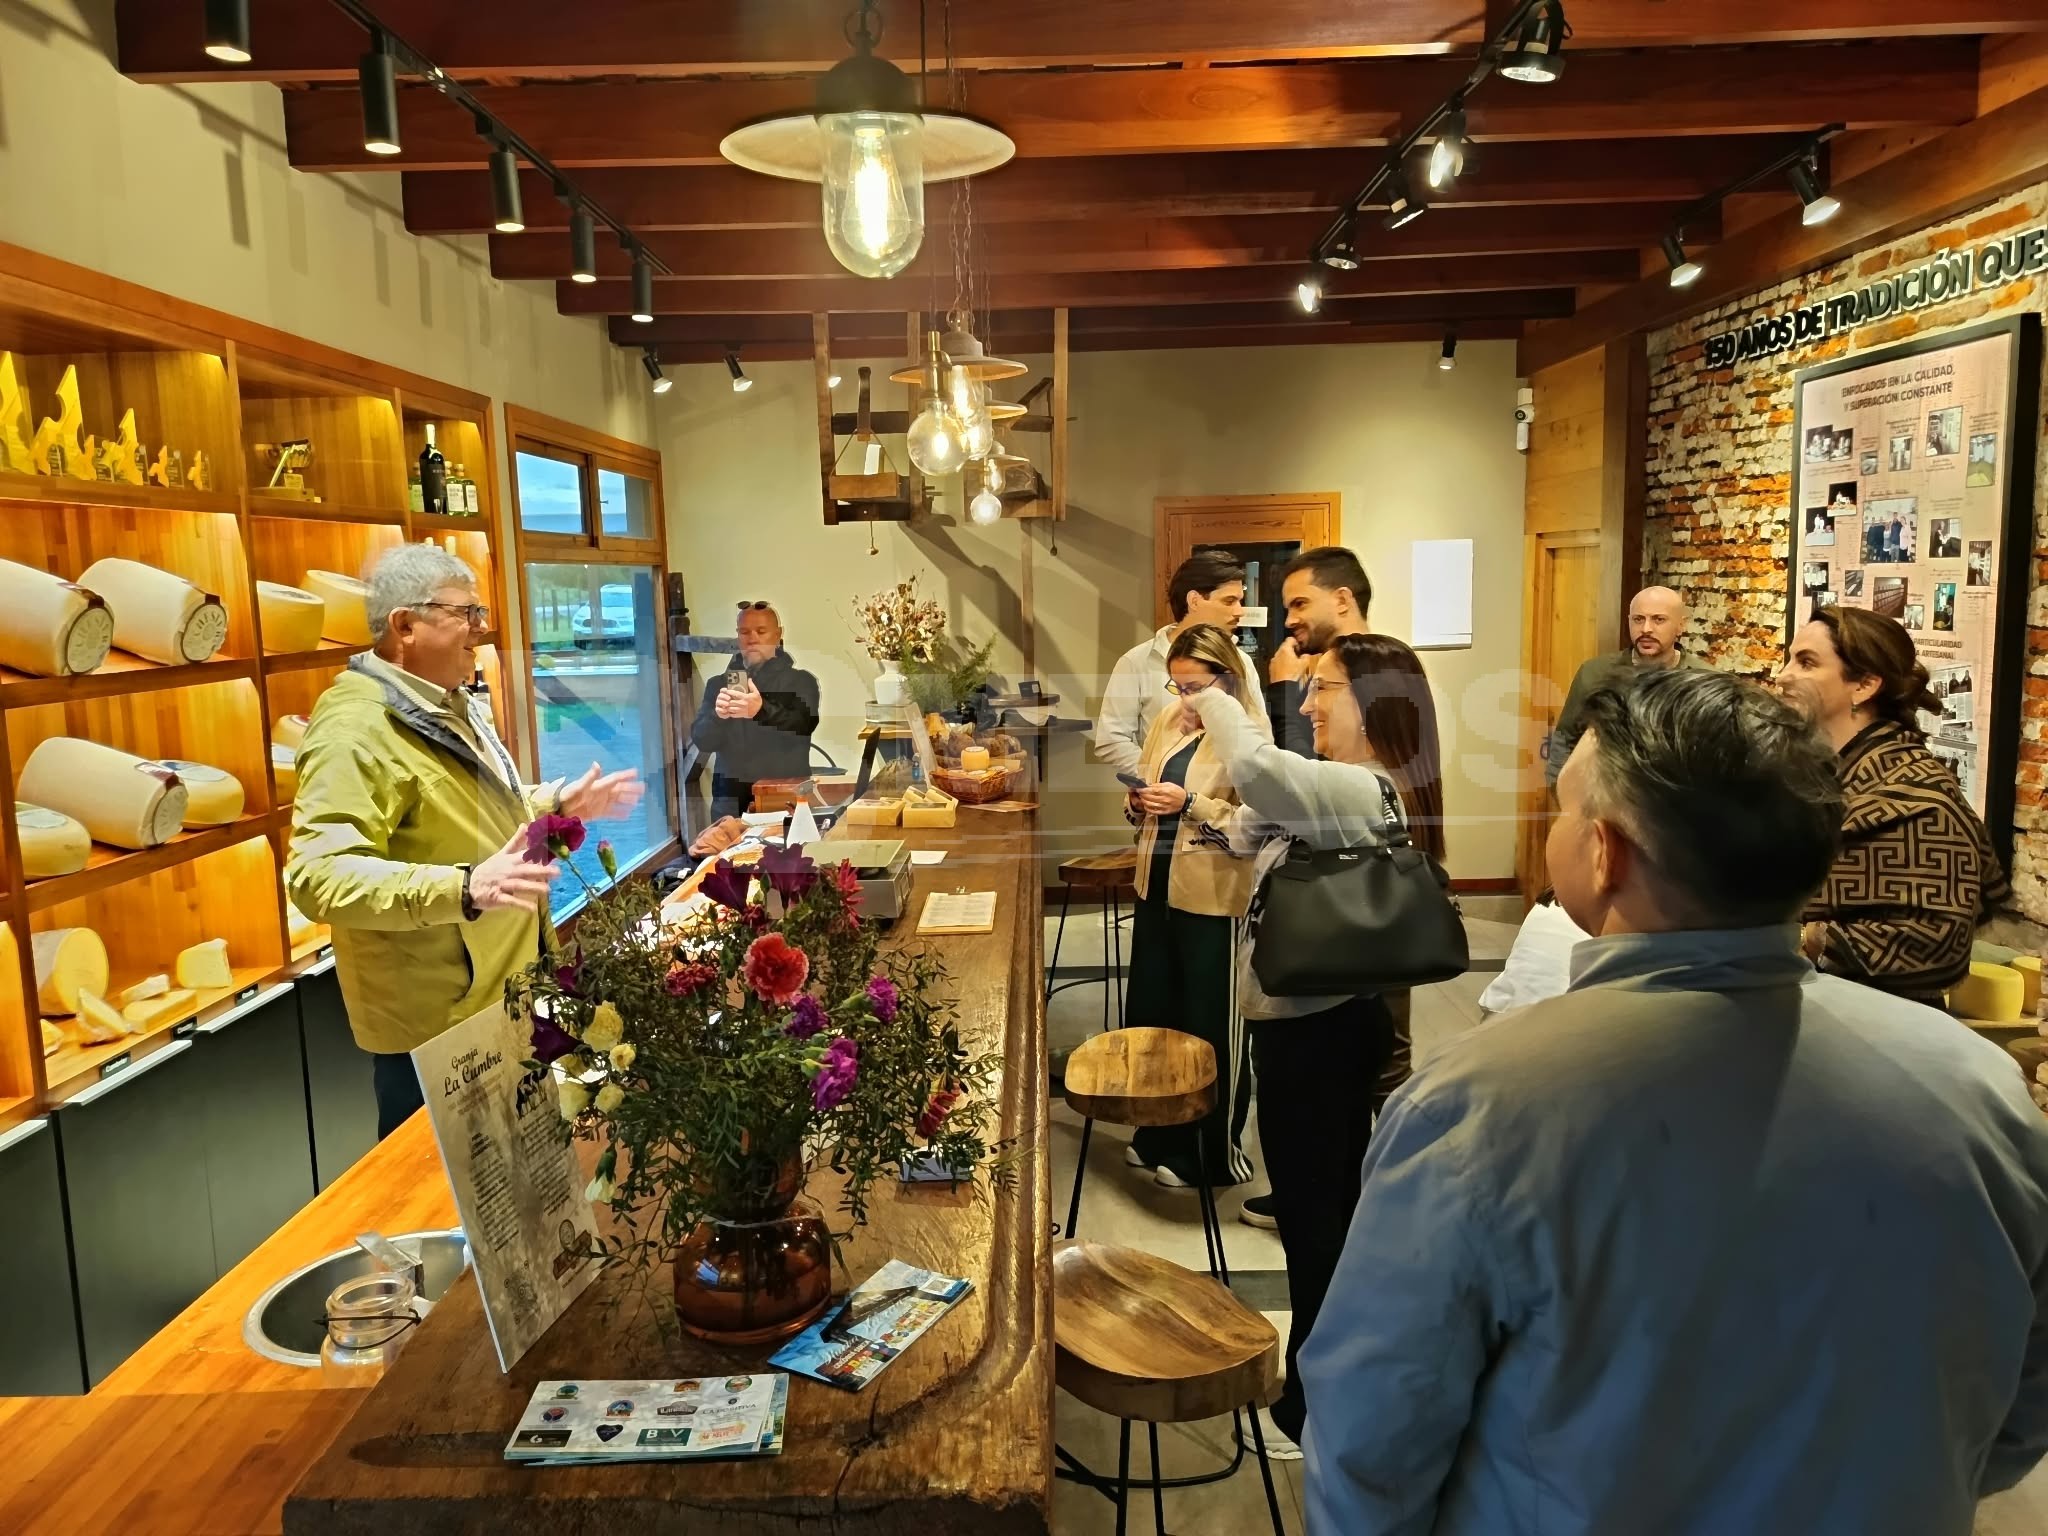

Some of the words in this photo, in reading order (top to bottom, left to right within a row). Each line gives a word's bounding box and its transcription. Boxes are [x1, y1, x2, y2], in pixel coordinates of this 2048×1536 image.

[1738, 315, 1795, 360] AÑOS
[1795, 302, 1826, 343] DE
[1827, 248, 1974, 335] TRADICIÓN
[1975, 225, 2048, 288] QUE
[1901, 374, 1913, 385] LA
[1900, 381, 1953, 402] CONSTANTE
[1914, 638, 1963, 649] PARTICULARIDAD
[451, 1048, 478, 1072] Granja
[445, 1077, 460, 1098] La
[462, 1051, 503, 1084] Cumbre
